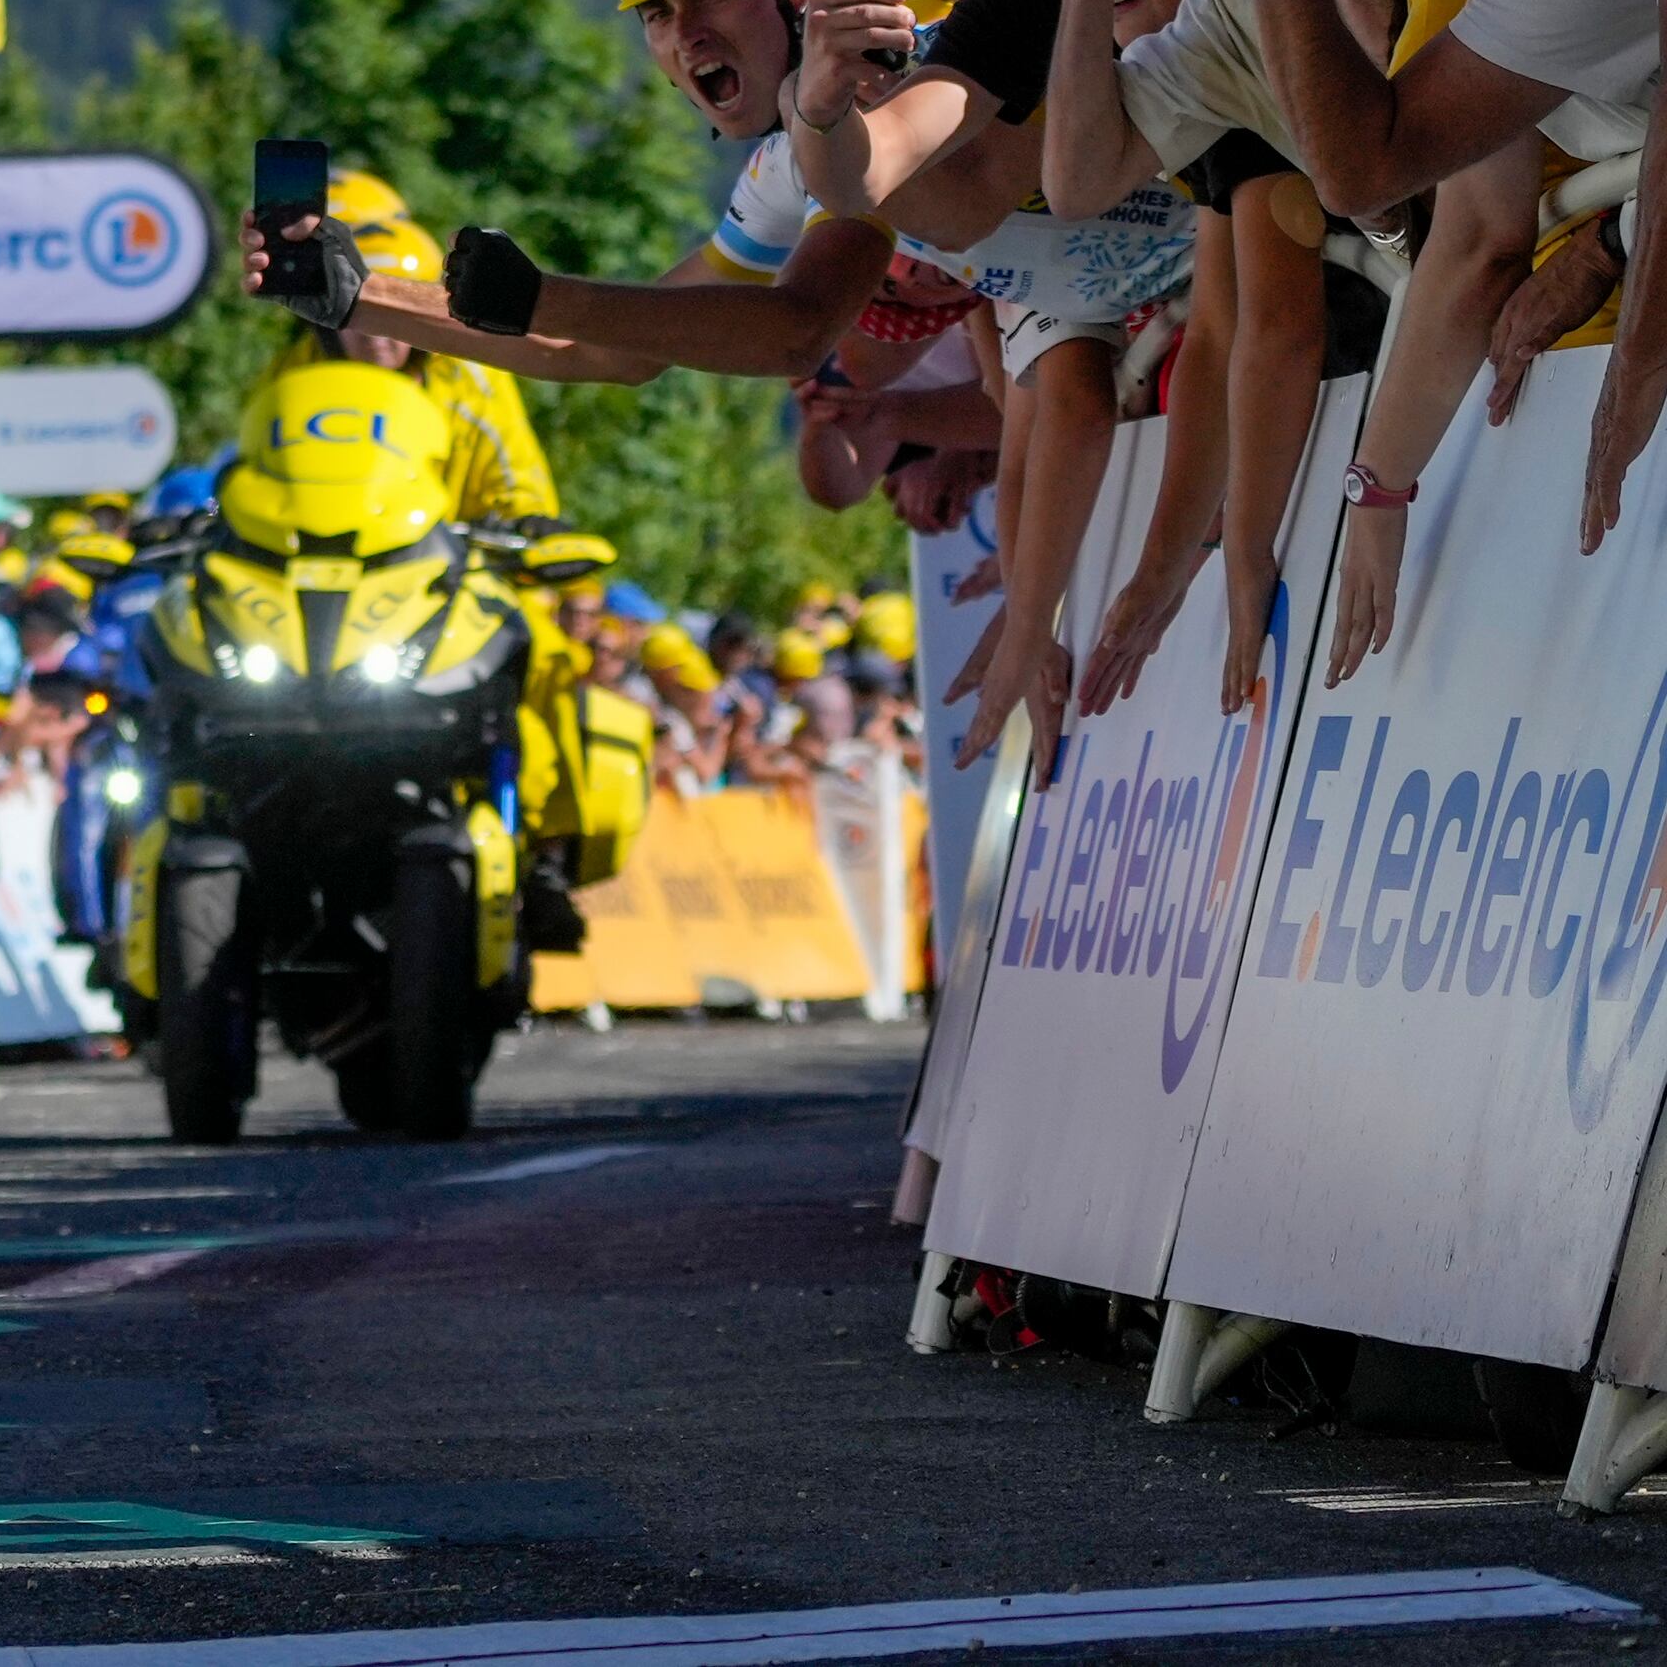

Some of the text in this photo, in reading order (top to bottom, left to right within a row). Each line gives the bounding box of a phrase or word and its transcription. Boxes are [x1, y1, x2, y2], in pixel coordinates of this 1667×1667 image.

[271, 408, 409, 460] LCL
[1001, 730, 1201, 979] E.Leclerc
[1256, 715, 1610, 998] E.Leclerc
